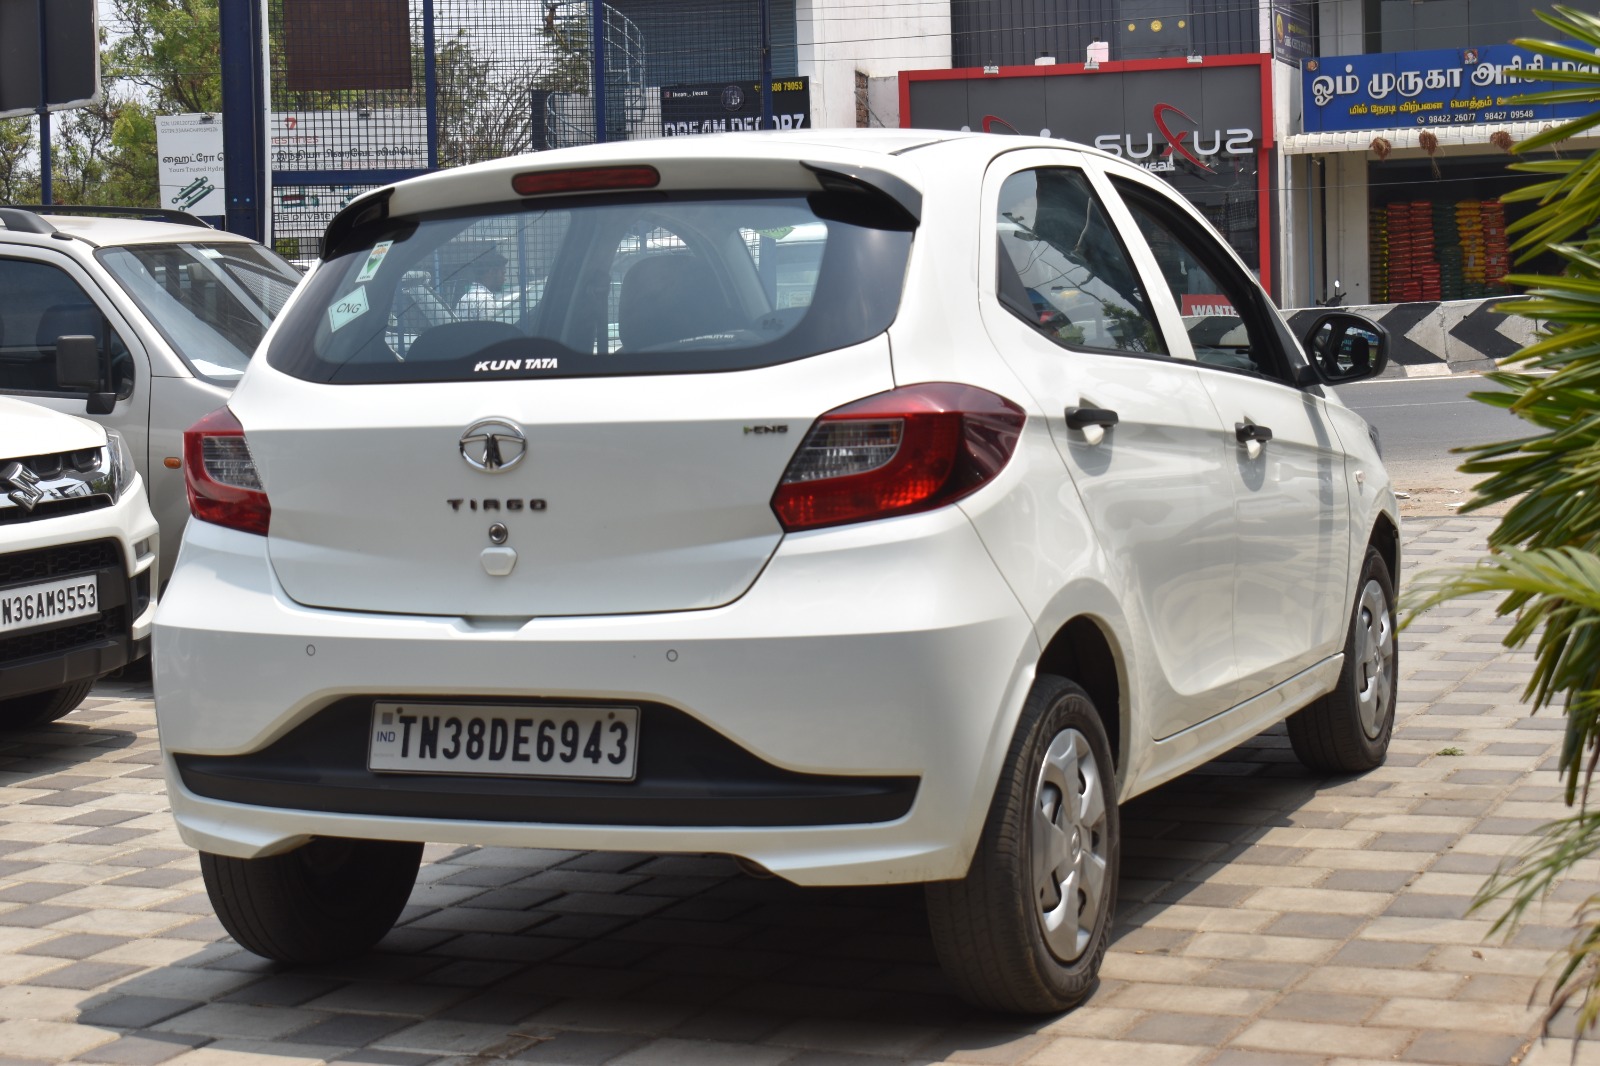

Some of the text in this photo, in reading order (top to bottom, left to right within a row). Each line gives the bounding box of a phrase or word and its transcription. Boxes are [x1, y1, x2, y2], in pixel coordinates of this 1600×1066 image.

[784, 82, 803, 91] 79053
[1312, 64, 1359, 106] ஓம்
[1367, 68, 1463, 99] முருகா
[1350, 104, 1368, 114] மில்
[1371, 104, 1396, 115] நேரடி
[1400, 101, 1444, 113] விற்பனை
[1450, 96, 1492, 109] மொத்தம்
[1429, 110, 1533, 123] 98422 26077 98427 09548
[664, 118, 726, 137] DREAM
[162, 153, 215, 166] ஹைட்ரோ
[336, 303, 362, 314] CNG
[1191, 305, 1237, 316] WANTE
[474, 358, 558, 371] KUN TATA
[446, 499, 547, 511] TIAGO
[2, 583, 96, 625] N36AM9553
[376, 731, 396, 742] IND
[399, 715, 629, 765] TN38DE6943
